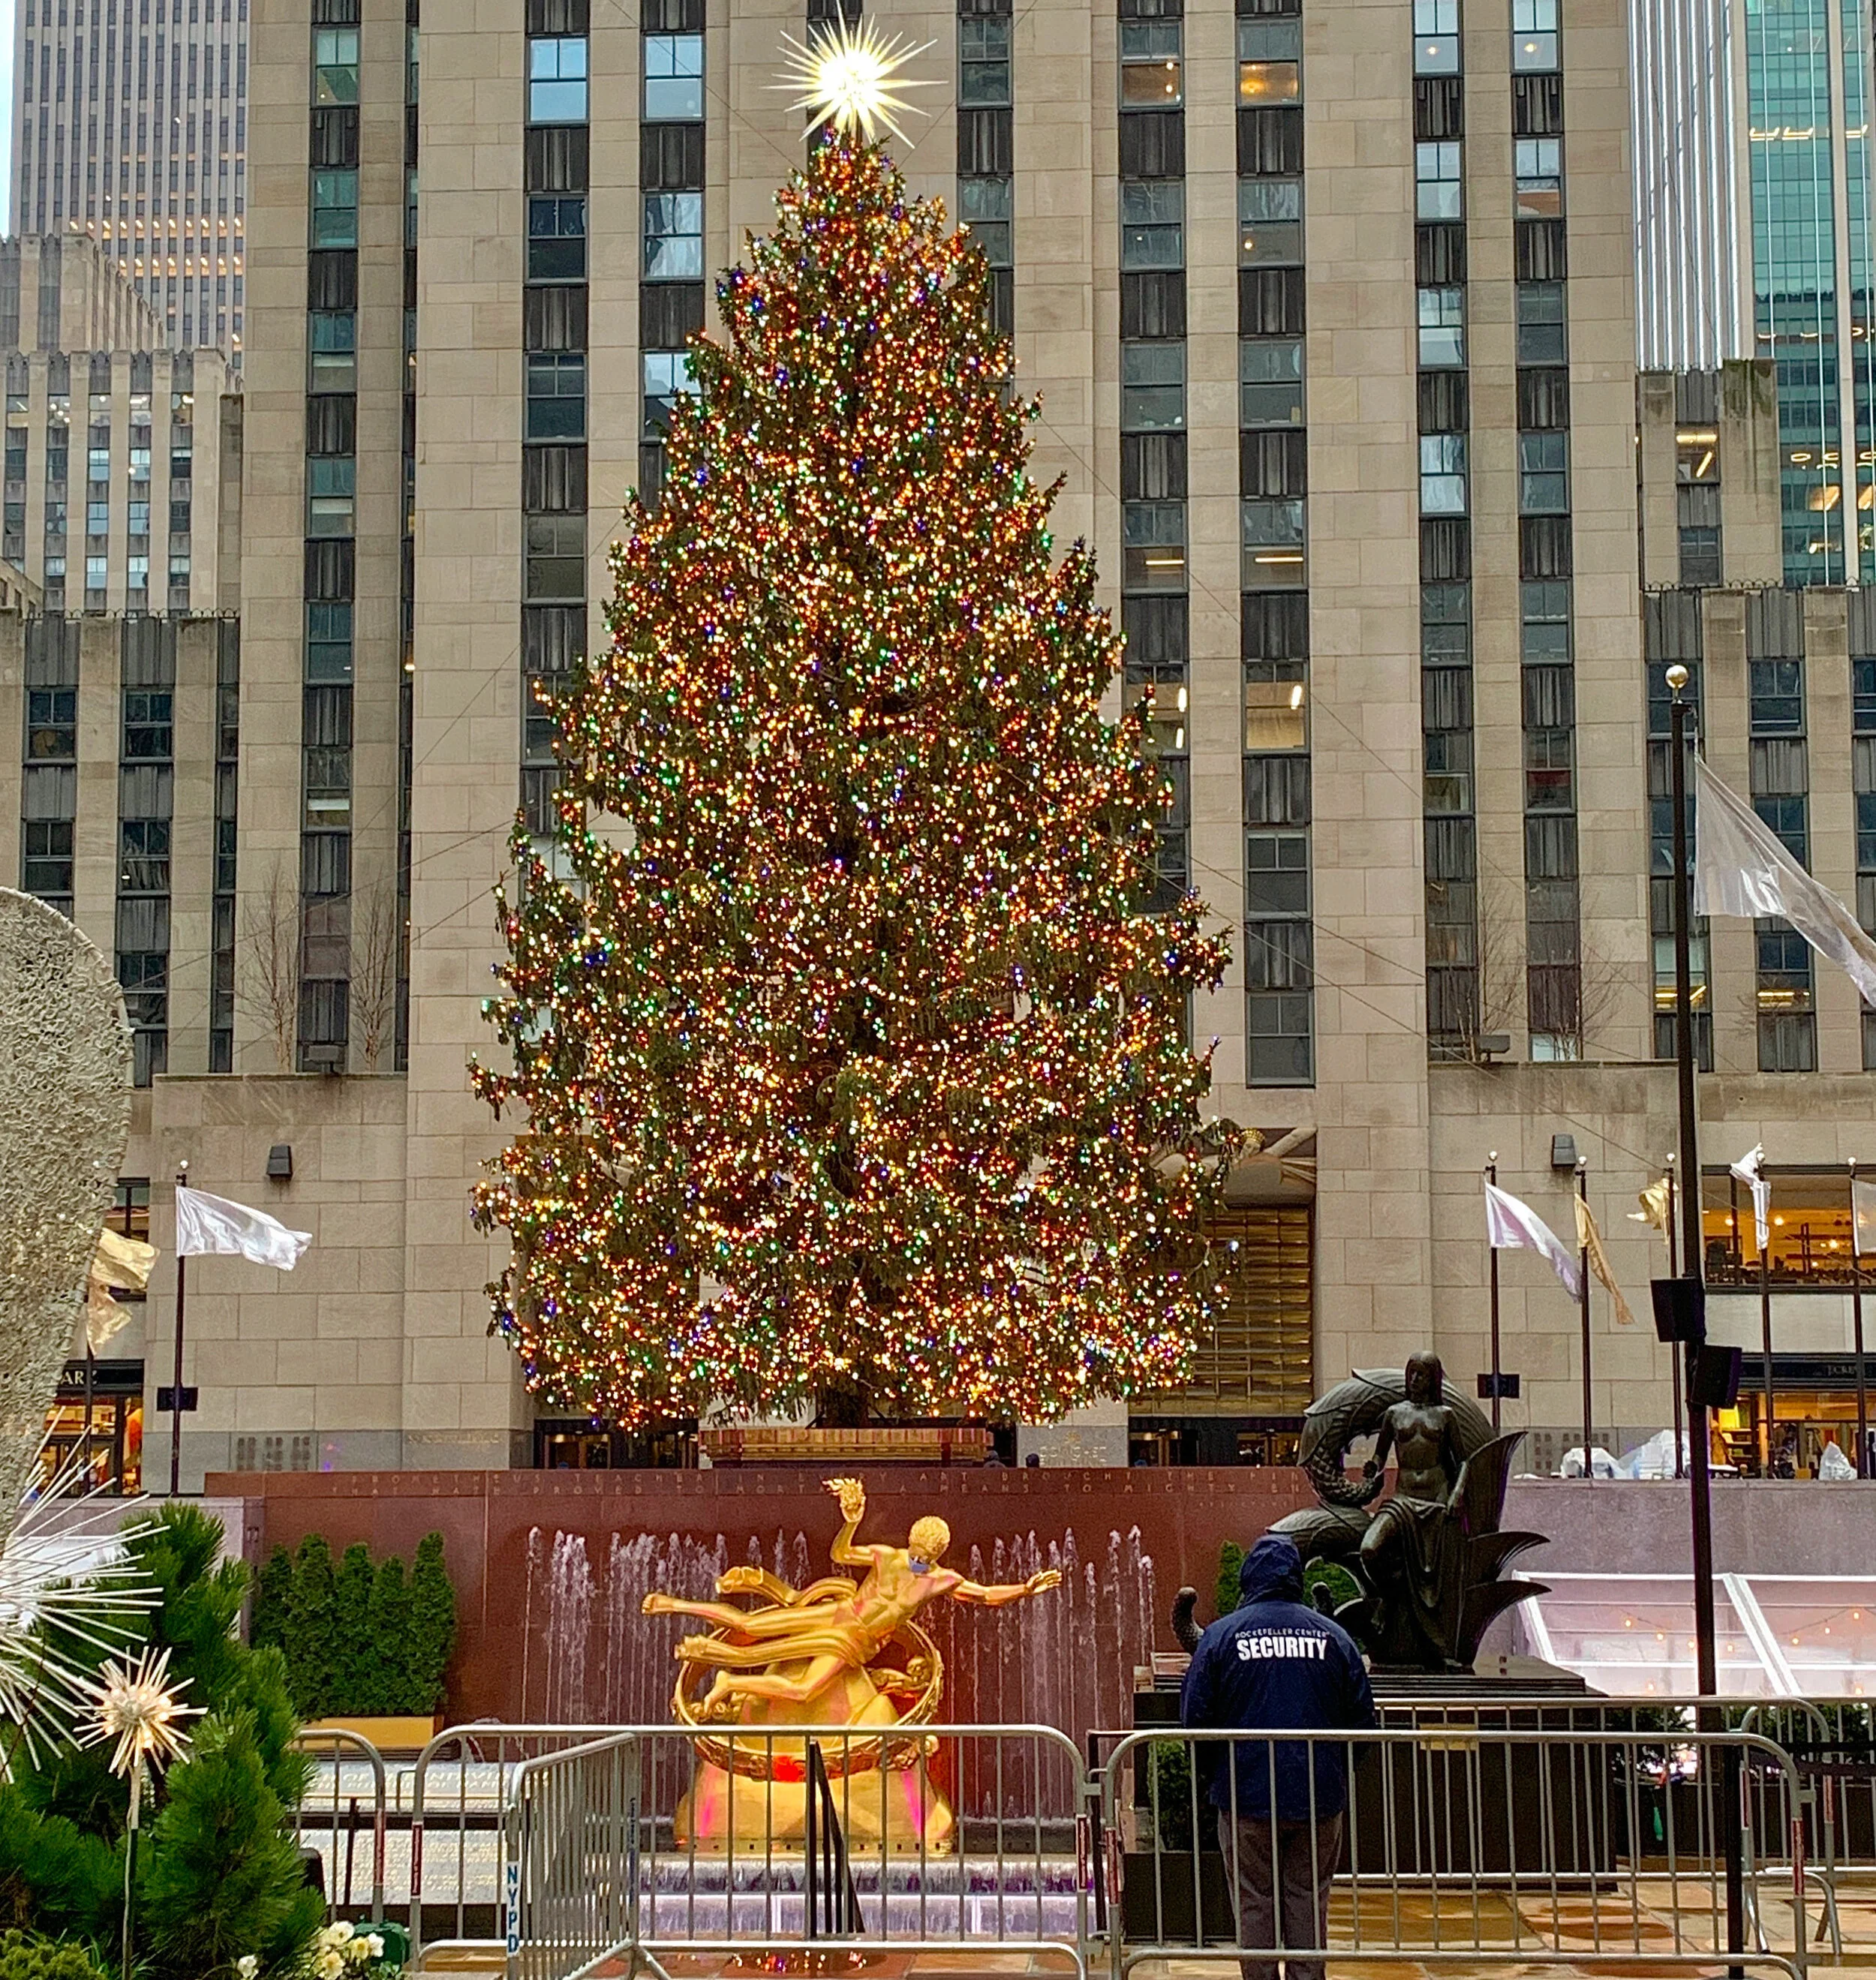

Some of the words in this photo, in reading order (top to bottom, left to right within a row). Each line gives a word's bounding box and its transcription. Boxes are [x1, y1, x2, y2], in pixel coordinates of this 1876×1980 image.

[919, 1471, 968, 1481] ART
[1167, 1471, 1215, 1481] THE
[533, 1485, 642, 1495] PROVED
[676, 1485, 705, 1494] TO
[1063, 1483, 1092, 1493] TO
[1235, 1627, 1293, 1639] ROCKEFELLER
[1237, 1636, 1327, 1661] SECURITY
[507, 1865, 519, 1953] NYPD
